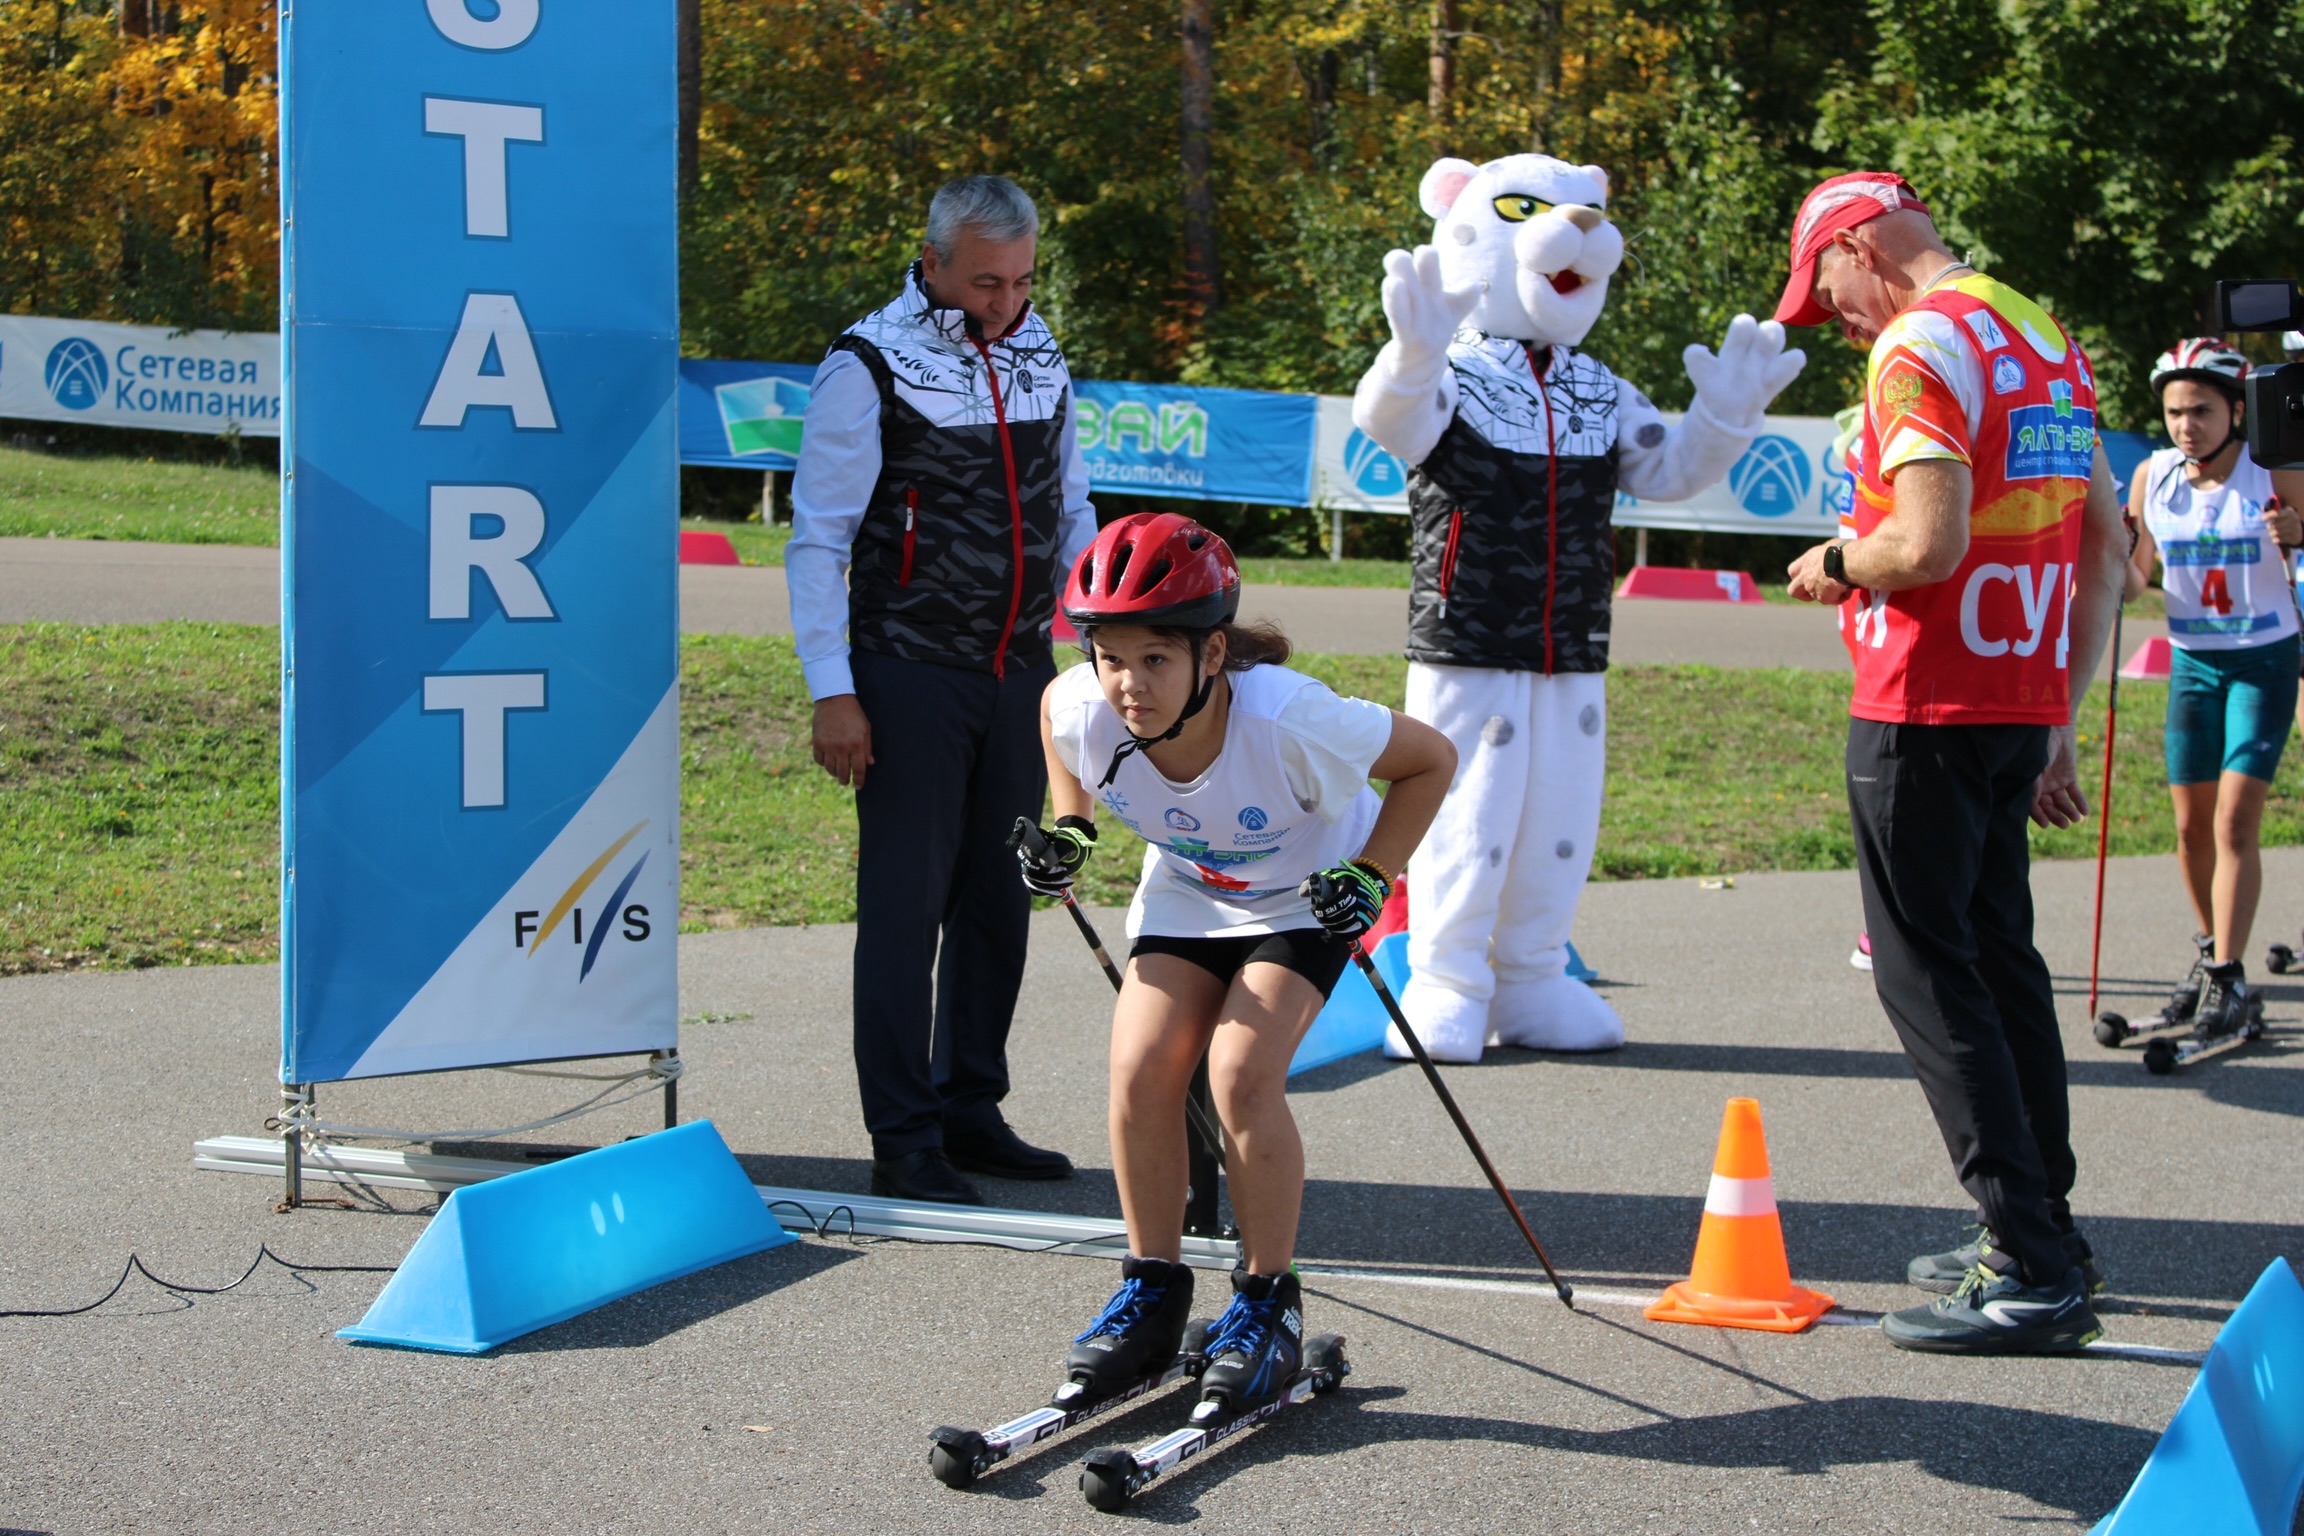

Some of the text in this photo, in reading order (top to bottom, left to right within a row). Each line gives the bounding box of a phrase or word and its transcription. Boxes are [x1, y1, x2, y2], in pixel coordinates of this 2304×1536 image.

[116, 345, 257, 384] Сетевая
[1084, 457, 1204, 486] одготовки
[2201, 568, 2234, 615] 4
[1325, 904, 1337, 915] Ski
[515, 904, 651, 948] FIS
[1075, 1395, 1126, 1423] CLASSIC
[1216, 1409, 1259, 1440] CLASSIC
